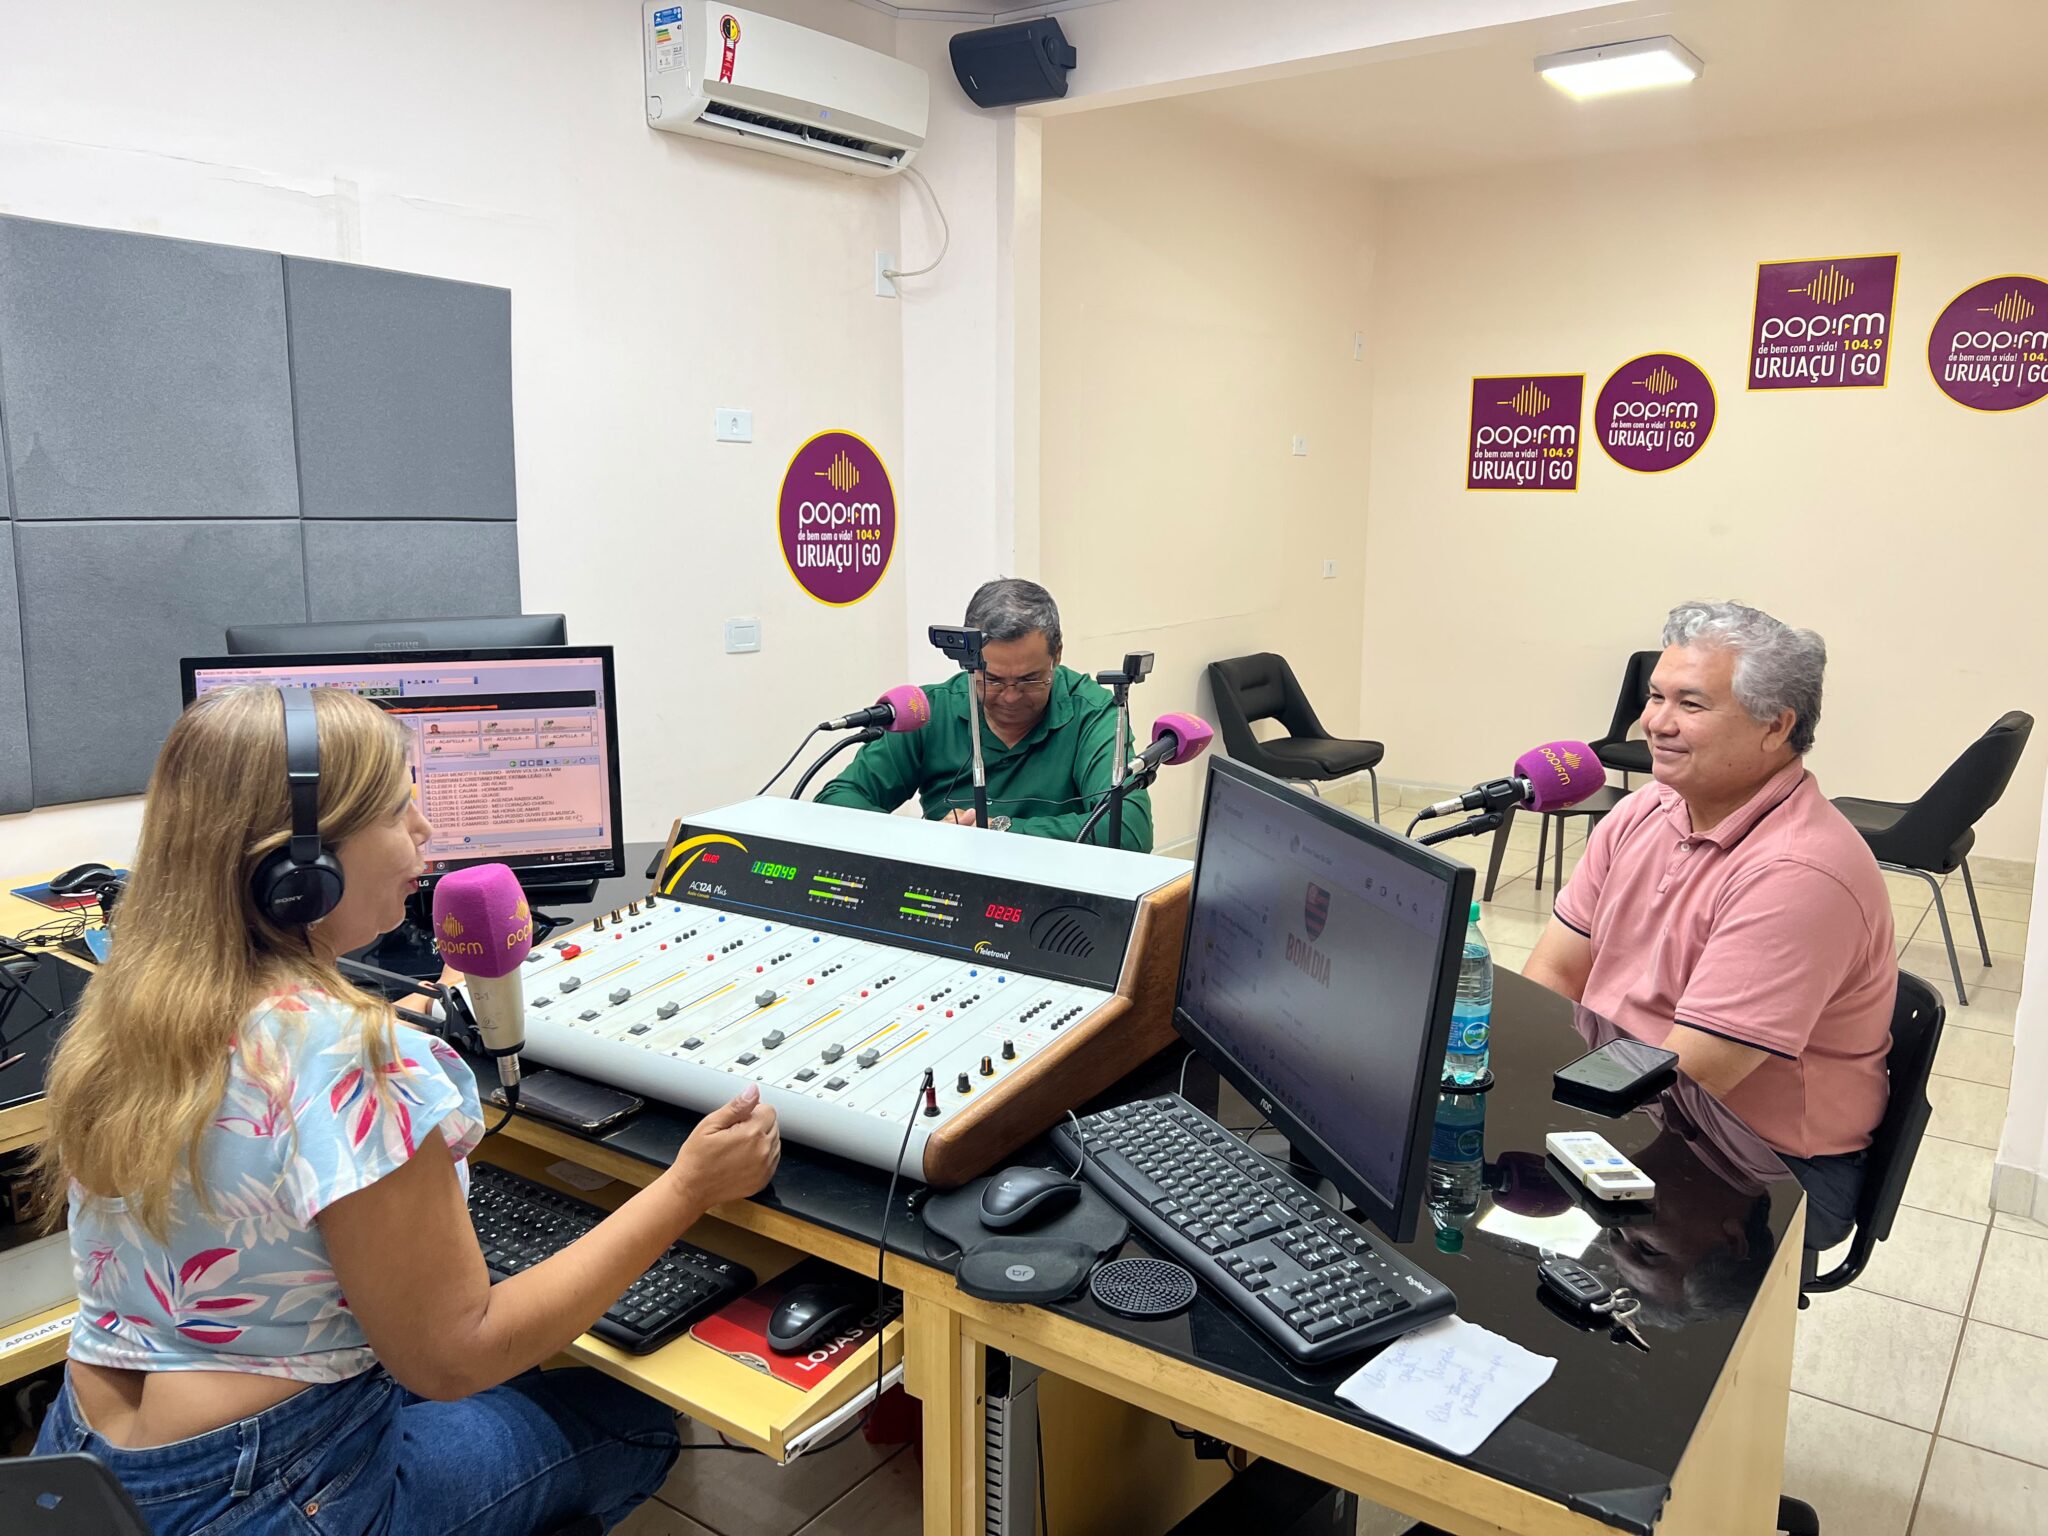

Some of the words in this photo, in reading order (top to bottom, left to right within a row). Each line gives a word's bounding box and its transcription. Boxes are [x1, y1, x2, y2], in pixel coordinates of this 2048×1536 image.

[1758, 344, 1768, 354] de
[1770, 343, 1788, 354] bem
[1790, 344, 1806, 353] com
[1816, 341, 1837, 352] vida!
[1843, 338, 1883, 351] 104.9
[1948, 353, 1958, 361] de
[1959, 352, 1975, 361] bem
[2023, 352, 2048, 361] 104.
[1754, 354, 1835, 383] URUAÇU
[1851, 353, 1881, 376] GO
[1944, 363, 2015, 387] URUAÇU
[1669, 420, 1696, 429] 104.9
[1608, 430, 1664, 451] URUAÇU
[1674, 431, 1695, 448] GO
[1474, 449, 1483, 458] de
[1484, 449, 1499, 458] bem
[1543, 448, 1574, 457] 104.9
[1472, 460, 1536, 485] URUAÇU
[1550, 461, 1573, 480] GO
[856, 529, 880, 540] 104.9
[796, 544, 852, 573] URUAÇU
[862, 543, 880, 566] GO
[713, 883, 728, 896] Plus
[275, 895, 304, 904] SONY
[985, 904, 1023, 923] 0226
[980, 947, 1010, 960] Teletronix
[1260, 1098, 1273, 1114] AOC
[1405, 1275, 1432, 1295] logitech
[6, 1324, 59, 1348] APOIAR
[794, 1327, 864, 1371] LOJAS
